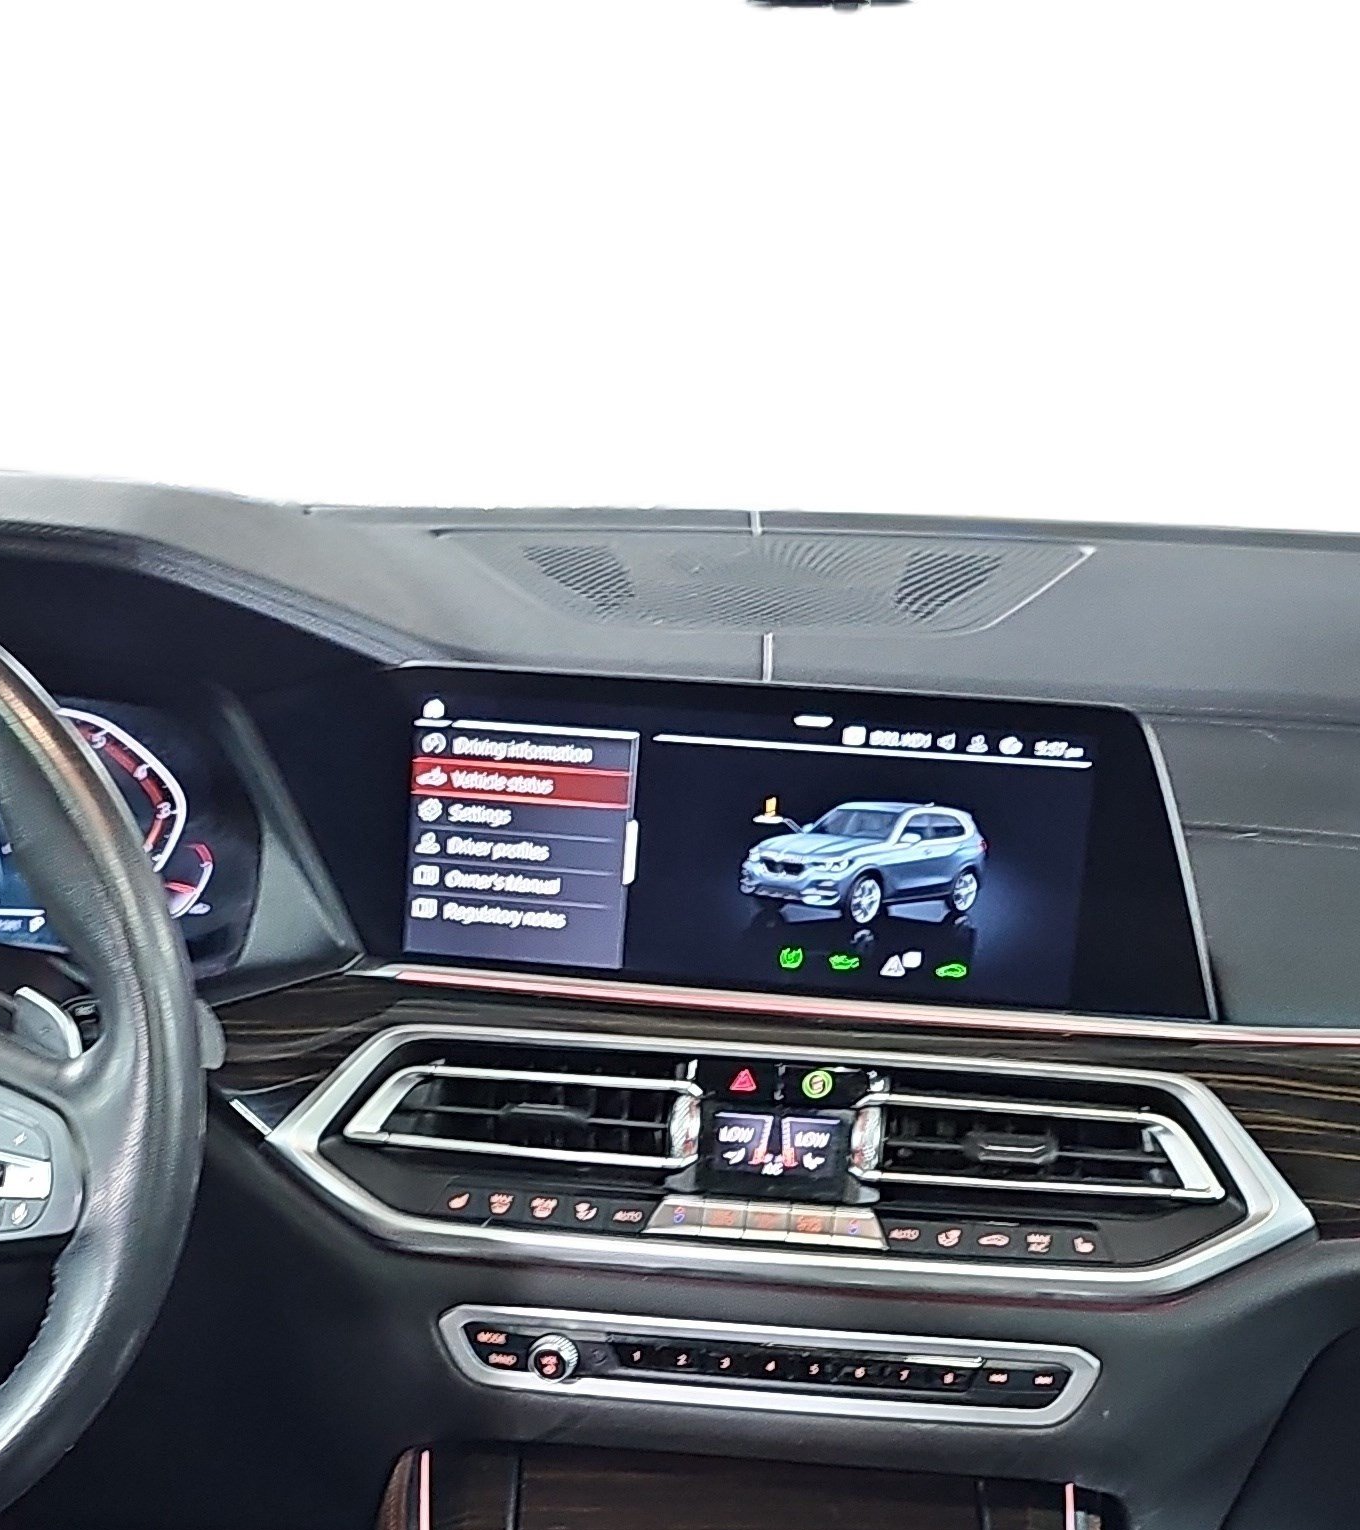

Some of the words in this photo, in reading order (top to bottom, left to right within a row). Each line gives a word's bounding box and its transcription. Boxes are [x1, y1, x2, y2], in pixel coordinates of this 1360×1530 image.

[452, 737, 507, 760] Driving
[506, 740, 593, 763] information
[450, 770, 507, 791] Vehicle
[505, 776, 554, 795] status
[448, 803, 511, 827] Settings
[446, 836, 494, 857] Driver
[491, 841, 550, 861] profiles
[444, 869, 505, 891] Owner's
[503, 874, 561, 895] Manual
[443, 902, 523, 928] Regulatory
[521, 911, 566, 929] notes
[718, 1126, 755, 1143] LOW
[794, 1131, 831, 1149] LOW
[676, 1353, 688, 1366] 2
